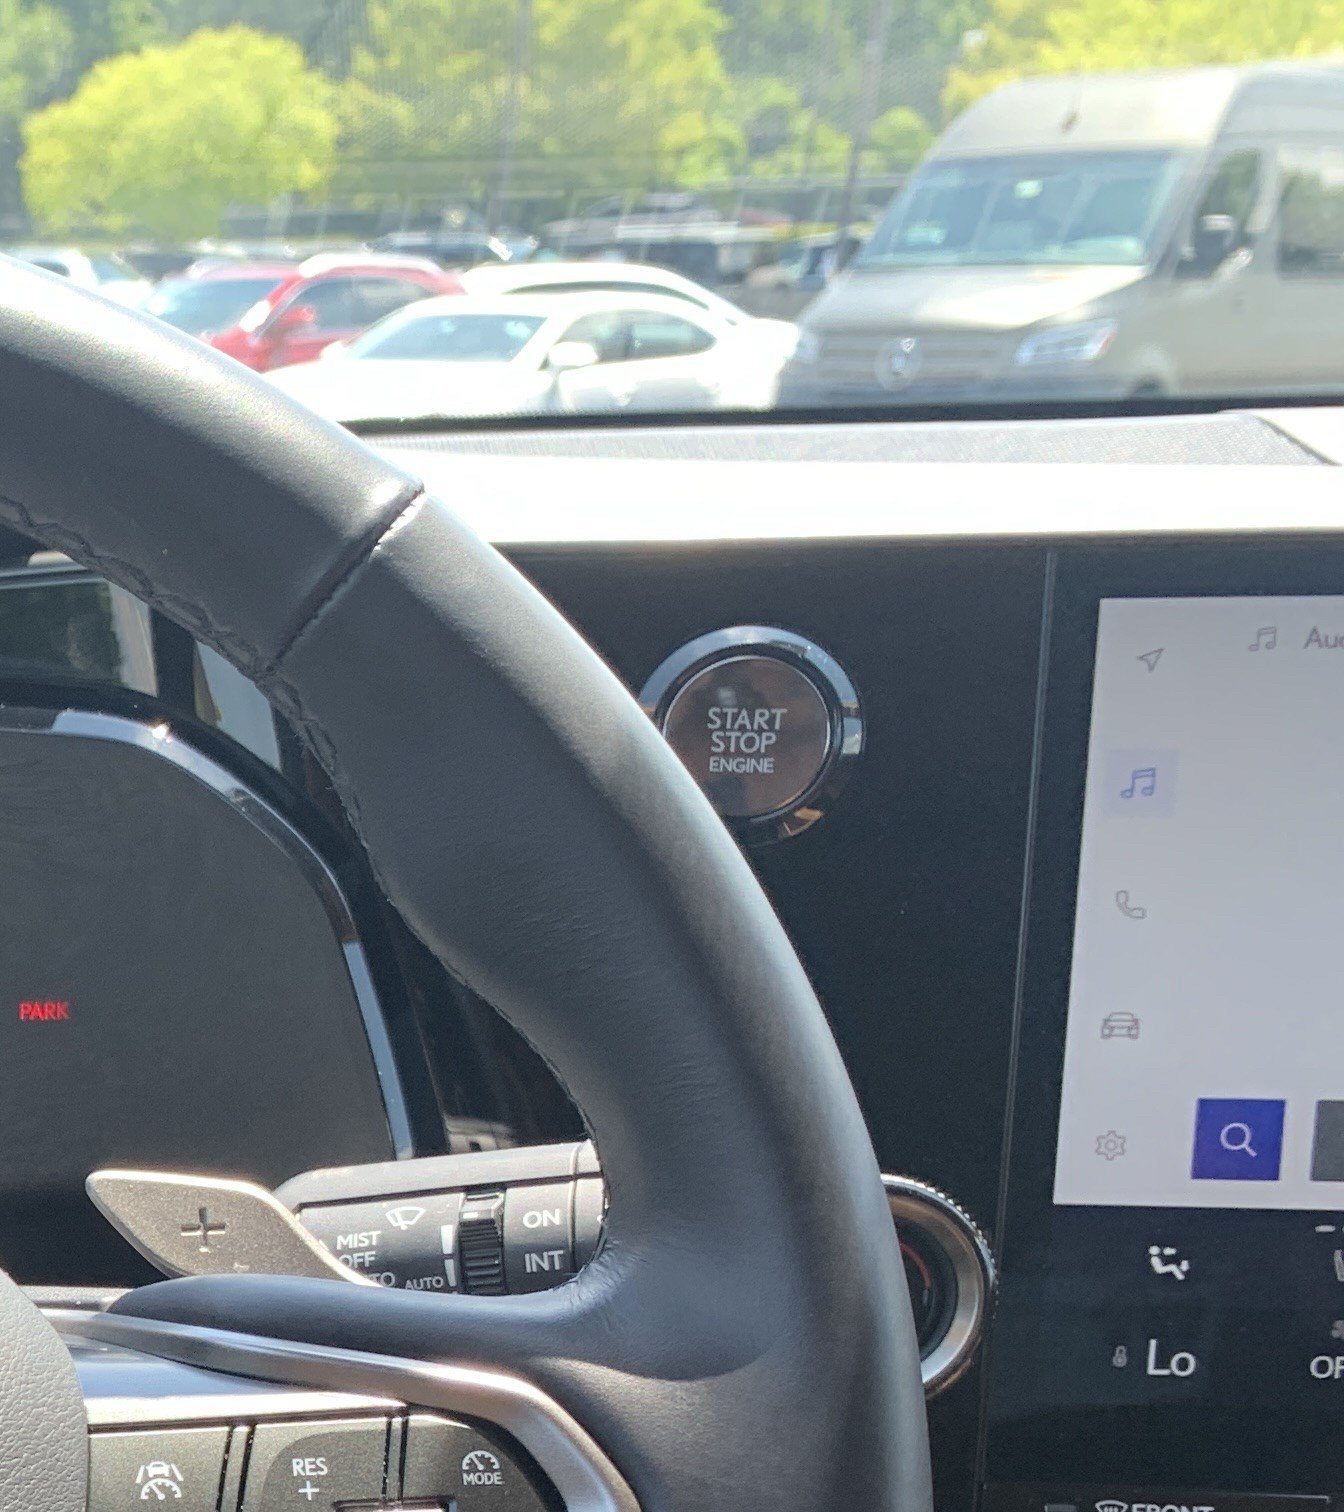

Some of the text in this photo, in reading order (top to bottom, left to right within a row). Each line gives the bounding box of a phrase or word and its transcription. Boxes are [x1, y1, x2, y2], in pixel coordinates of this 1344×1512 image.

[707, 707, 788, 731] START
[711, 731, 777, 754] STOP
[709, 756, 775, 774] ENGINE
[18, 1001, 70, 1020] PARK
[523, 1208, 561, 1229] ON
[337, 1231, 381, 1250] MIST
[524, 1250, 565, 1274] INT
[405, 1276, 444, 1290] AUTO
[1147, 1338, 1196, 1377] Lo
[291, 1457, 328, 1477] RES
[463, 1472, 503, 1486] MODE
